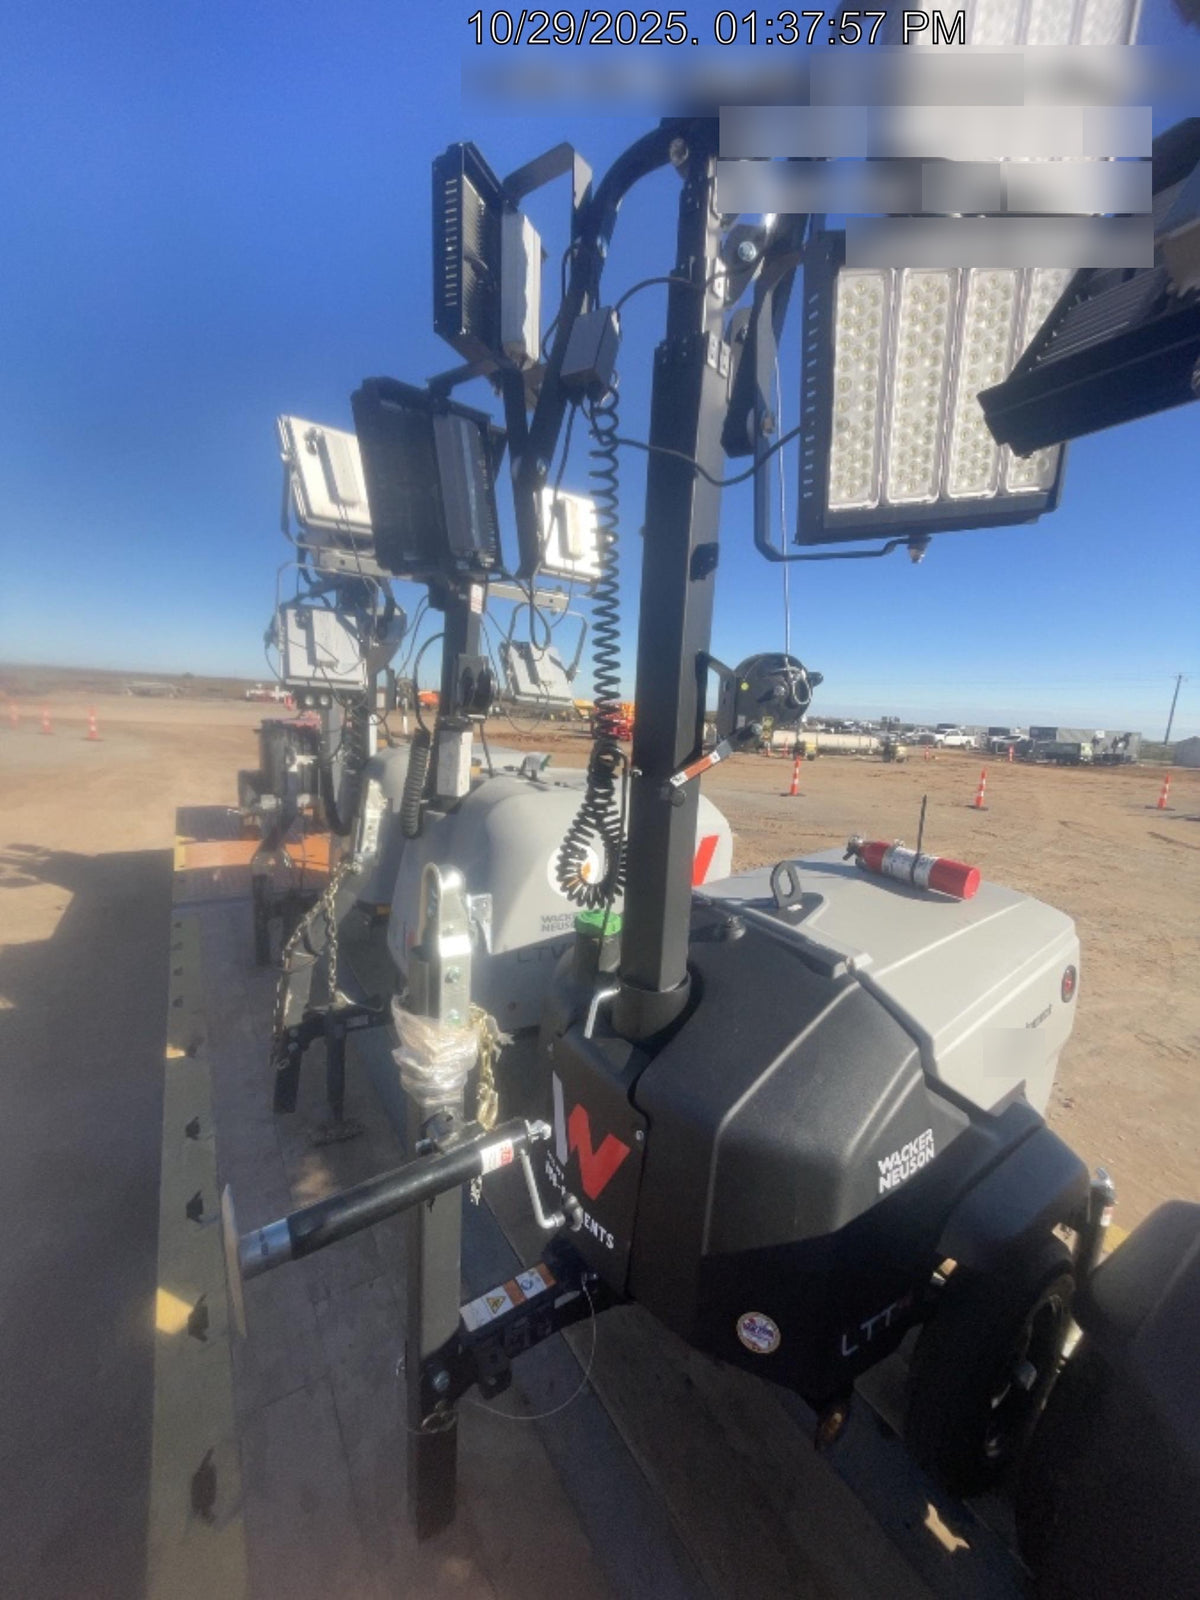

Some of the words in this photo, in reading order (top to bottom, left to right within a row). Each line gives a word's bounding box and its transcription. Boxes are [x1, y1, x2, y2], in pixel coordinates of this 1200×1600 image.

[878, 1128, 934, 1175] WACKER
[879, 1142, 935, 1194] NEUSON
[582, 1211, 615, 1250] ENTS
